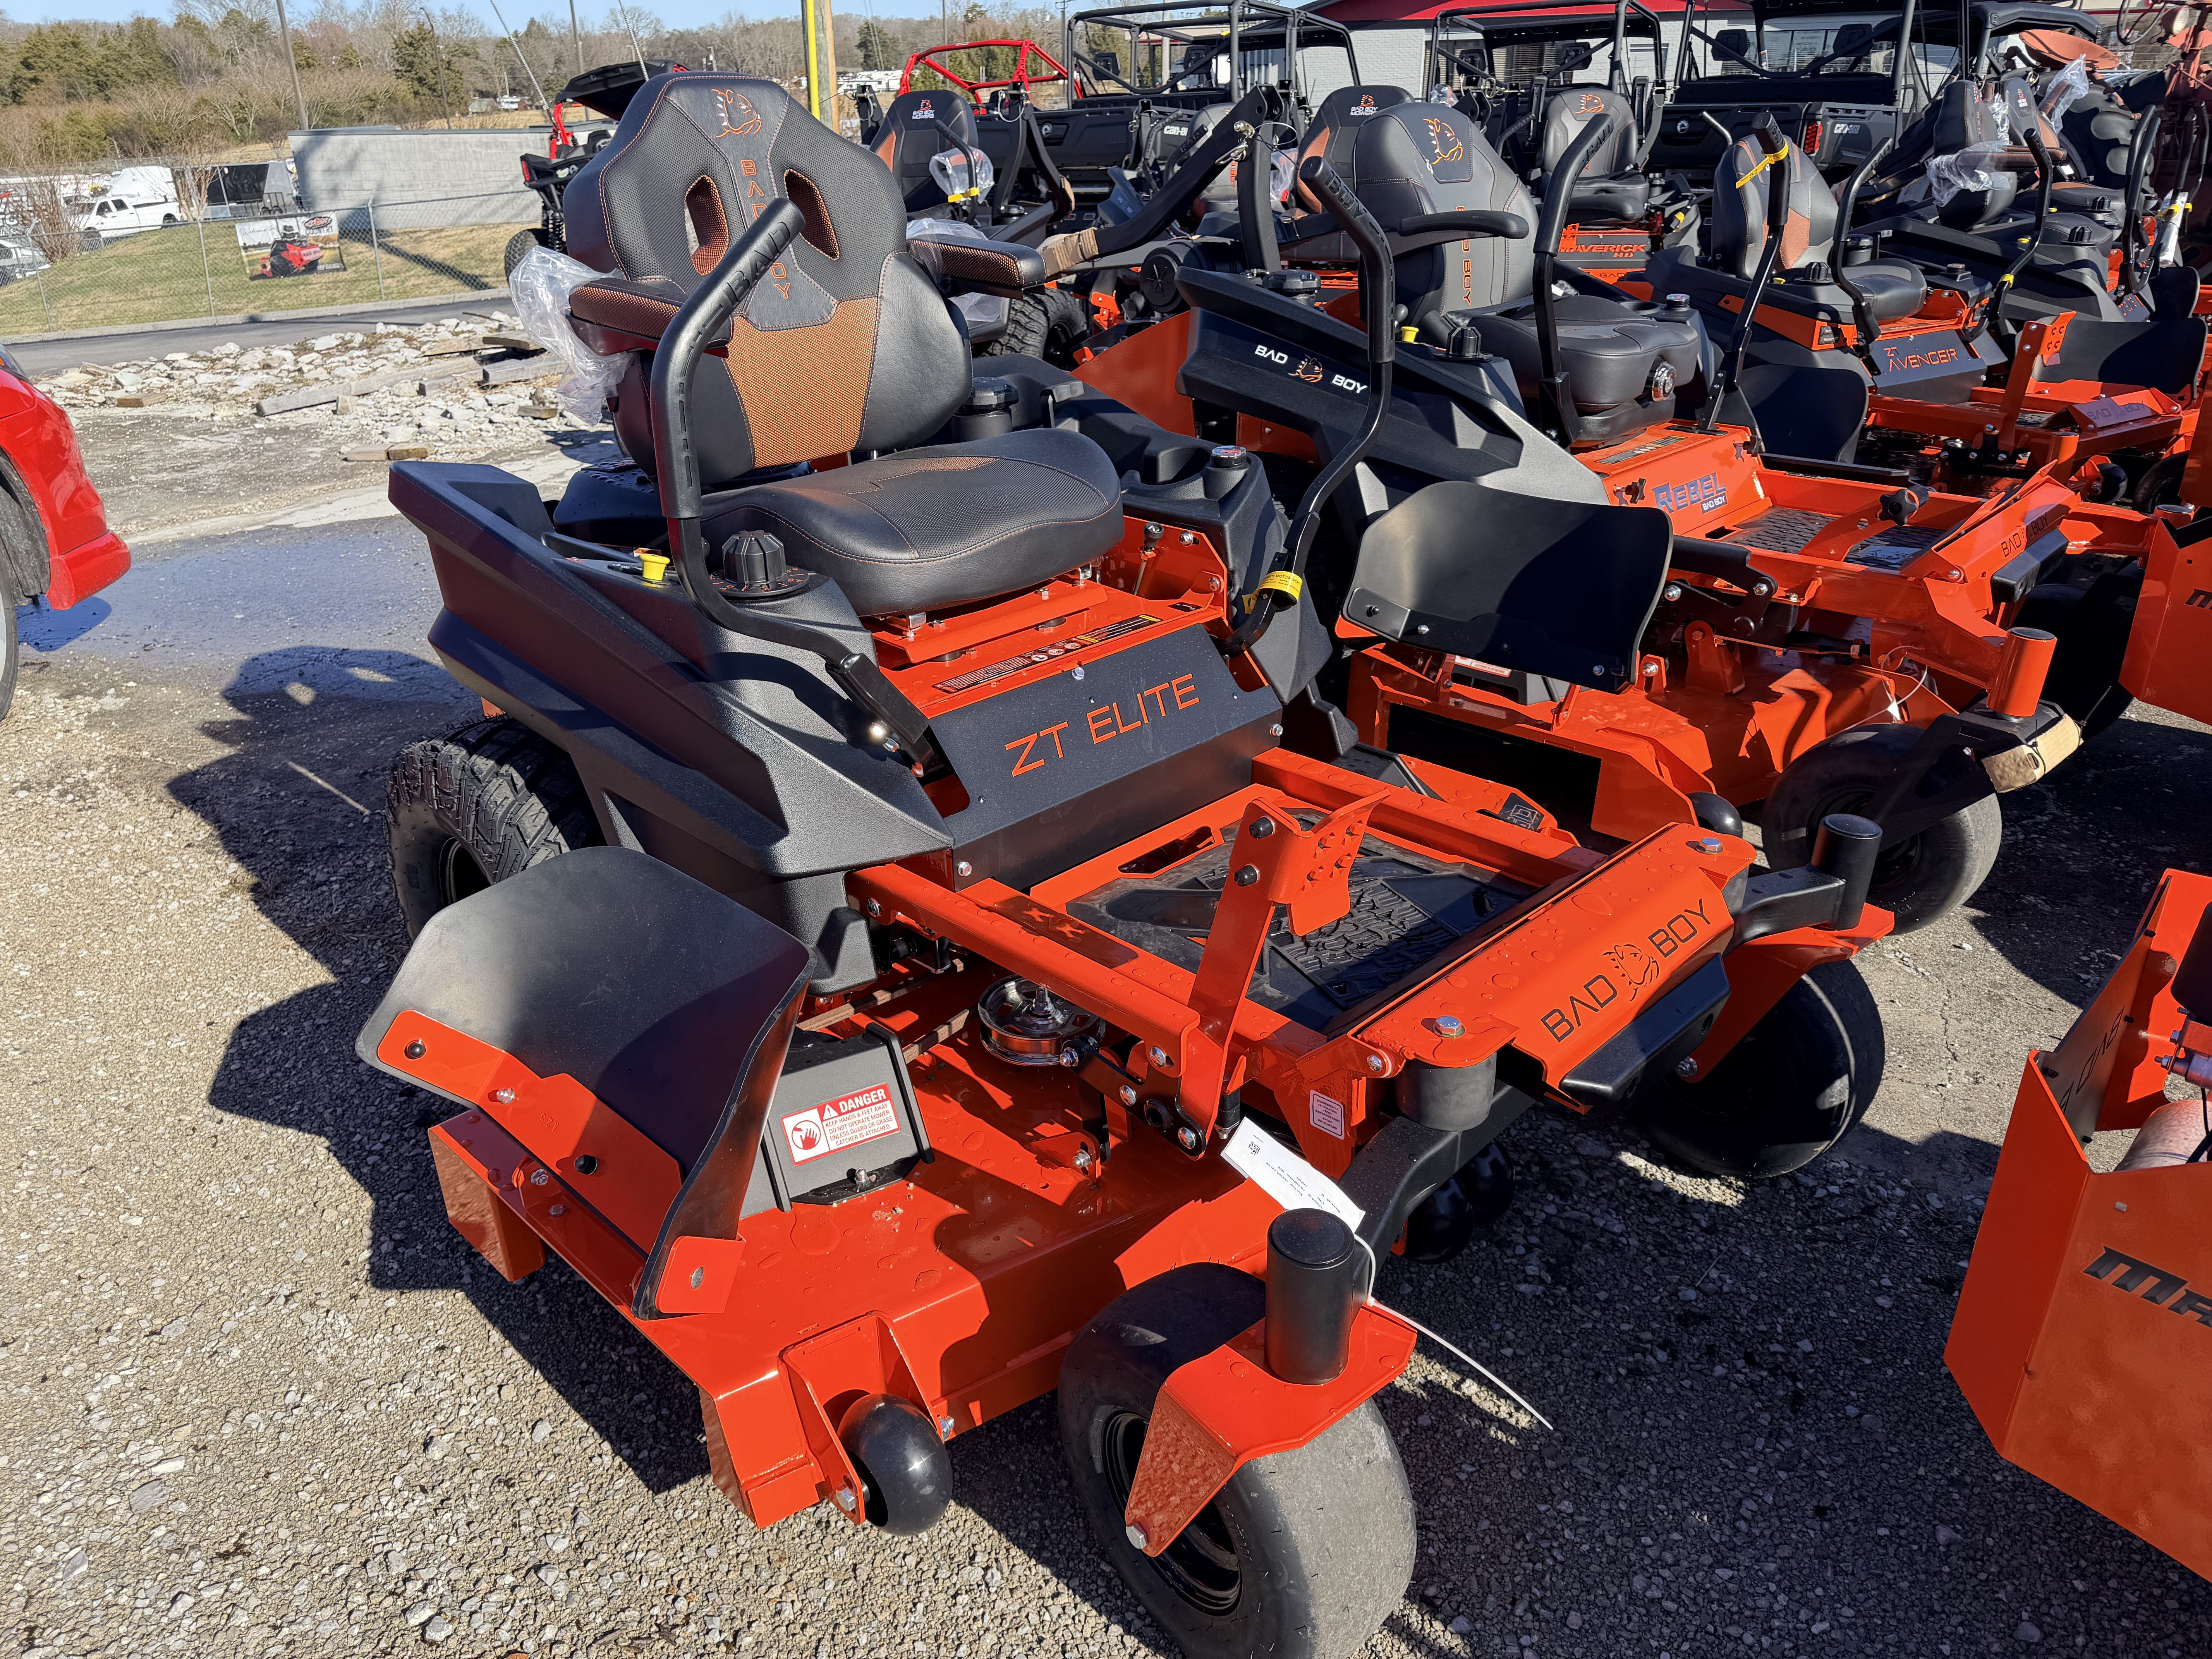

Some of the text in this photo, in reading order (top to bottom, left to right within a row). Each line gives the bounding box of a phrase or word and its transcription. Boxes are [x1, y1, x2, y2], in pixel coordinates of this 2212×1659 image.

[1163, 125, 1188, 136] can-a
[1834, 124, 1860, 134] can-am
[1324, 170, 1367, 220] BOY
[722, 222, 791, 302] BAD
[770, 262, 791, 299] OY
[1463, 259, 1472, 307] BOY
[1255, 345, 1368, 393] BAD BOY
[1889, 349, 1958, 372] AVENGER
[1652, 472, 1726, 513] REBEL
[1702, 496, 1726, 510] BAD BOY
[2001, 512, 2048, 557] BAD BOY
[1005, 721, 1069, 777] ZT
[1086, 673, 1200, 745] ELITE
[1540, 898, 1711, 1043] BAD BOY
[838, 1089, 886, 1113] DANGER
[826, 1120, 838, 1128] KEEP
[839, 1114, 856, 1123] HANDS
[830, 1130, 850, 1141] UNLESS
[850, 1124, 867, 1134] GUARD
[876, 1116, 893, 1125] GRASS
[848, 1116, 870, 1128] OPERATE
[871, 1110, 890, 1120] MOWER
[836, 1135, 858, 1146] CATCHER
